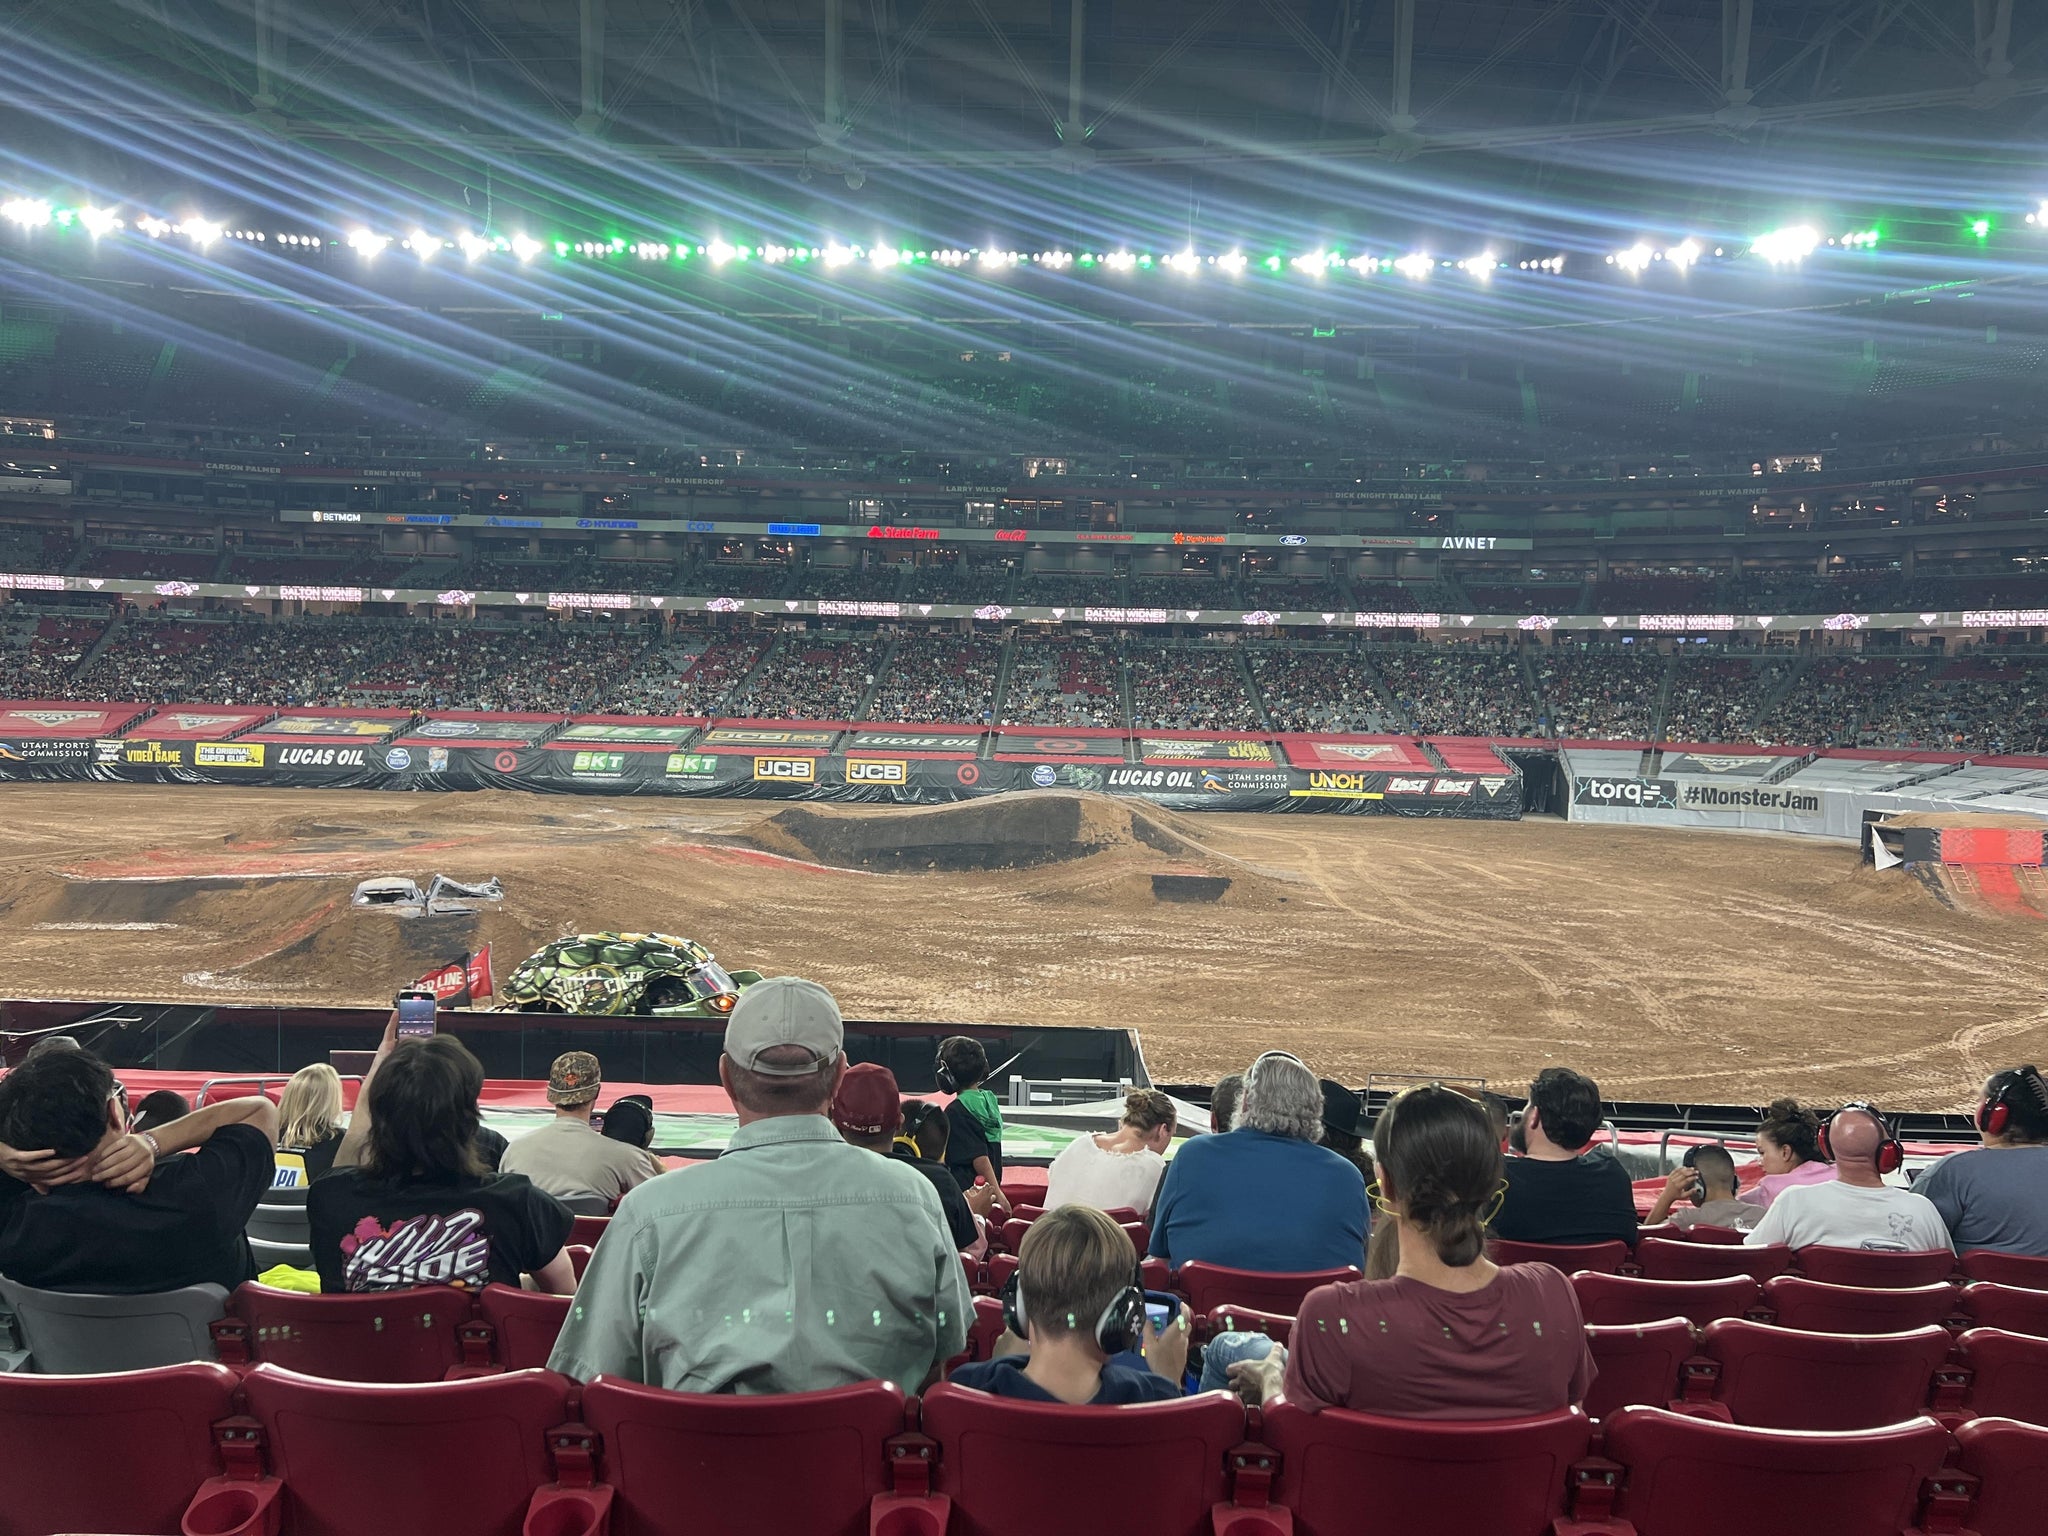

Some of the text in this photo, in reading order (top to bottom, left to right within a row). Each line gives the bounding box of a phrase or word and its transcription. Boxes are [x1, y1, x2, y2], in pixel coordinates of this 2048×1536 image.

[206, 462, 281, 474] CARSON PALMER
[363, 469, 422, 478] ERNIE NEVERS
[1699, 487, 1768, 496] KURT WARNER
[323, 512, 361, 522] BETMGM
[593, 520, 638, 529] HYUNDAI
[687, 521, 715, 532] COX
[1441, 536, 1497, 550] AVNET
[15, 577, 65, 586] WIDNER
[280, 588, 320, 597] DALTON
[321, 589, 362, 598] WIDNER
[548, 595, 631, 604] DALTON WIDNER
[817, 602, 900, 612] DALTON WIDNER
[1084, 609, 1167, 619] DALTON WIDNER
[1354, 614, 1440, 623] DALTON WIDNER
[1962, 613, 2017, 622] DALTON
[1639, 617, 1734, 626] DALTON WIDNER
[855, 736, 937, 746] LUCAS
[148, 742, 161, 751] THE
[200, 746, 250, 755] THE ORIGINAL
[126, 750, 153, 762] VIDEO
[155, 750, 181, 763] GAME
[200, 754, 225, 762] SUPER
[278, 748, 335, 765] LUCAS
[575, 755, 623, 768] BKT
[668, 757, 716, 770] BKT
[758, 759, 811, 777] JCB
[850, 763, 902, 780] JCB
[1108, 769, 1164, 787] LUCAS
[1254, 774, 1288, 782] SPORTS
[1309, 772, 1364, 790] UNOH
[1684, 786, 1819, 811] #MonsterJam
[436, 971, 463, 988] LINE
